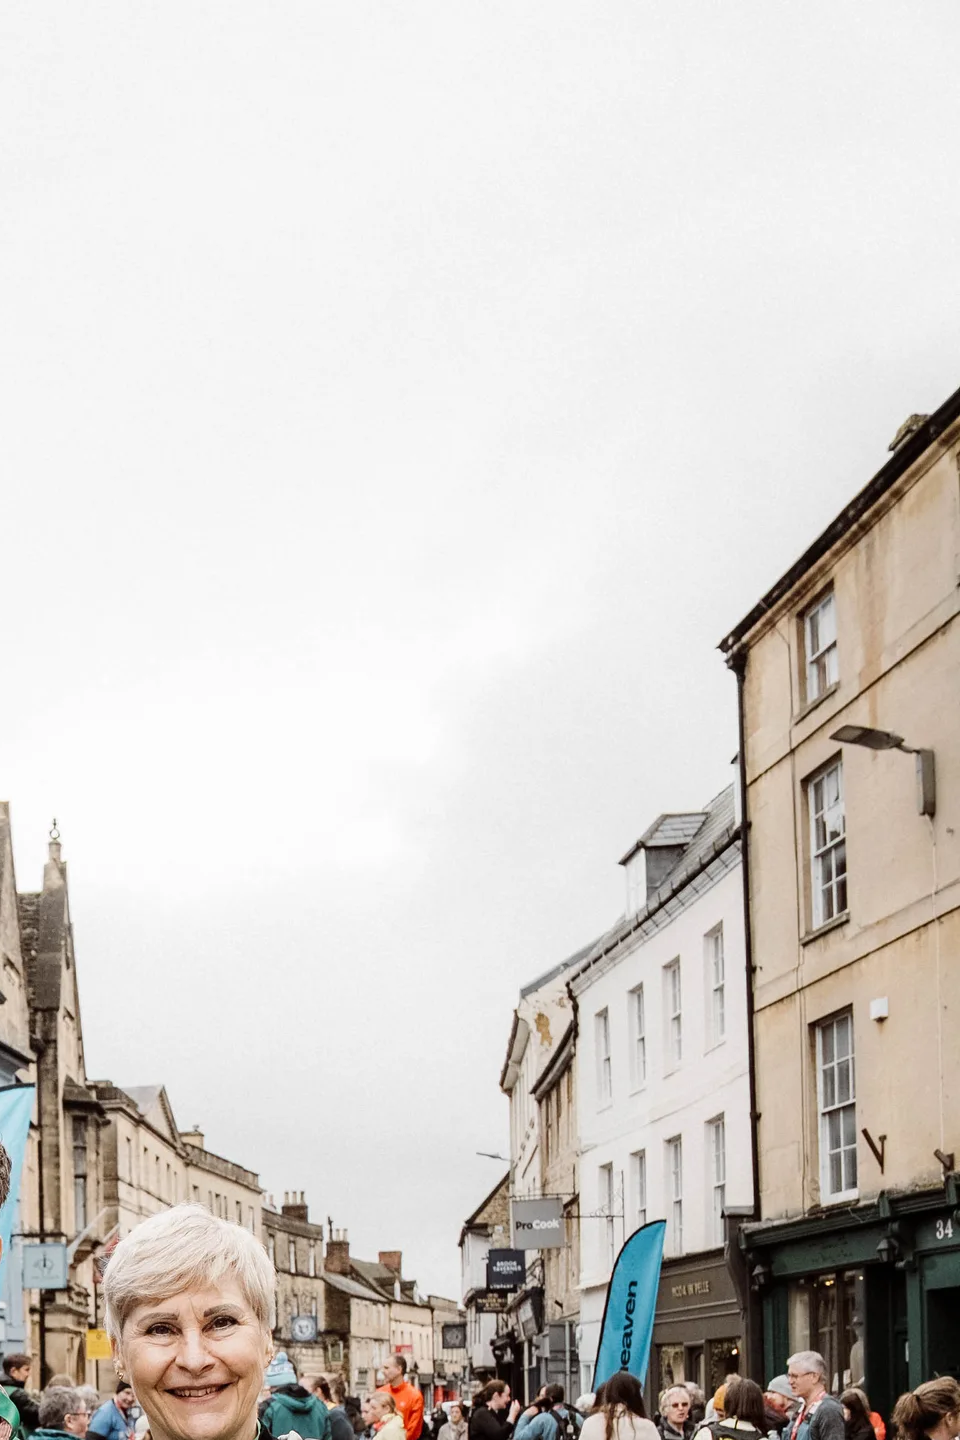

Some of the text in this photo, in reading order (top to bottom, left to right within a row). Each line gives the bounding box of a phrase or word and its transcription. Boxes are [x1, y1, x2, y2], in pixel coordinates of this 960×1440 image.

[515, 1219, 560, 1231] ProCook
[936, 1219, 954, 1240] 34
[620, 1280, 638, 1371] eaven
